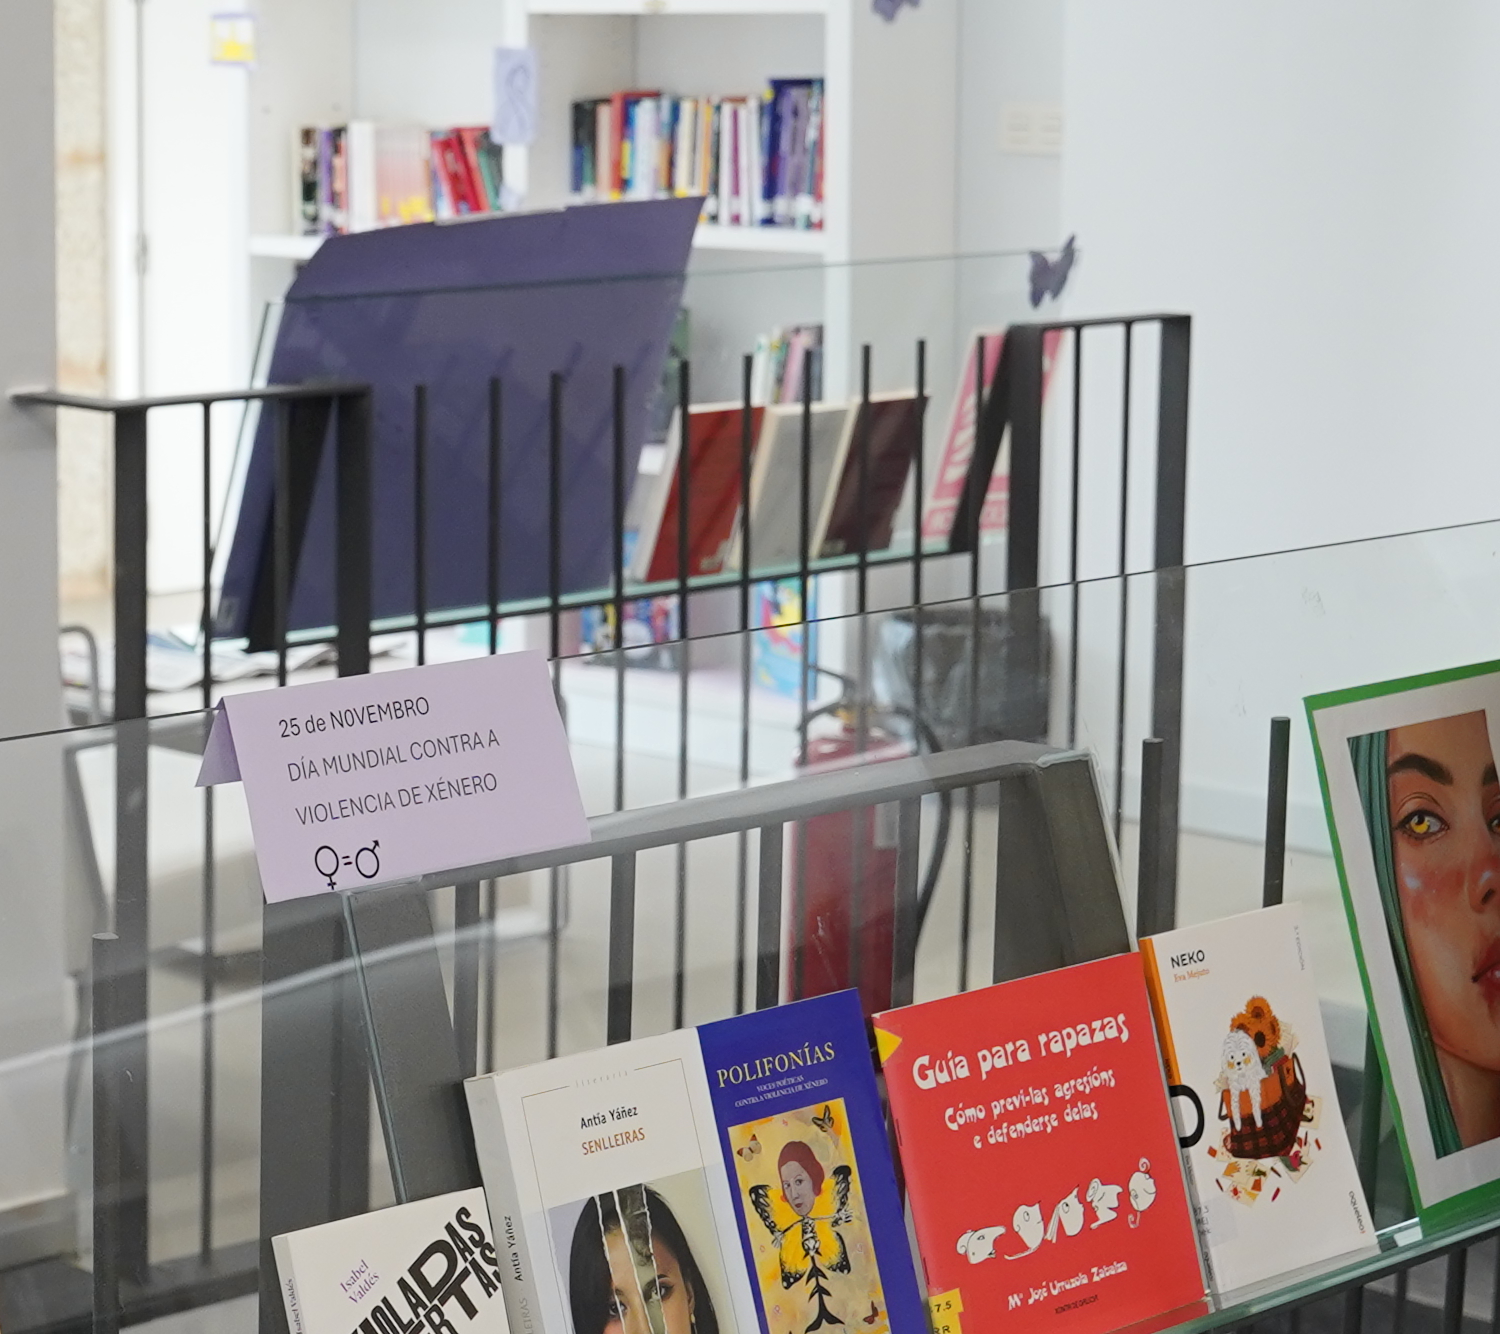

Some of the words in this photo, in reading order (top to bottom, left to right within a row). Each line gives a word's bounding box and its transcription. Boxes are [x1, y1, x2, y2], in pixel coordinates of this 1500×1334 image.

[278, 717, 301, 738] 25
[305, 714, 327, 734] de
[329, 696, 430, 730] NOVEMBRO
[287, 755, 320, 782] DÍA
[322, 745, 407, 777] MUNDIAL
[409, 732, 485, 761] CONTRA
[487, 728, 500, 748] A
[295, 791, 396, 825] VIOLENCIA
[398, 786, 423, 807] DE
[425, 772, 498, 802] XÉNERO
[1170, 949, 1205, 969] NEKO
[1173, 972, 1186, 983] Eva
[716, 1042, 835, 1088] POLIFONÍAS
[912, 1050, 970, 1090] Guía
[977, 1038, 1031, 1081] para
[1038, 1013, 1129, 1058] rapazas
[944, 1102, 986, 1131] Cómo
[991, 1086, 1049, 1120] previ-las
[1054, 1065, 1116, 1100] agresións
[580, 1112, 607, 1129] Antía
[608, 1105, 639, 1122] Yáñez
[973, 1135, 982, 1149] e
[987, 1113, 1059, 1145] defenderse
[1063, 1100, 1099, 1122] delas
[581, 1127, 646, 1155] SENLLEIRAS
[505, 1216, 517, 1249] Yáñez
[340, 1259, 369, 1294] Isabel
[512, 1252, 524, 1282] Antía
[348, 1271, 380, 1304] Valdés
[1027, 1281, 1048, 1305] José
